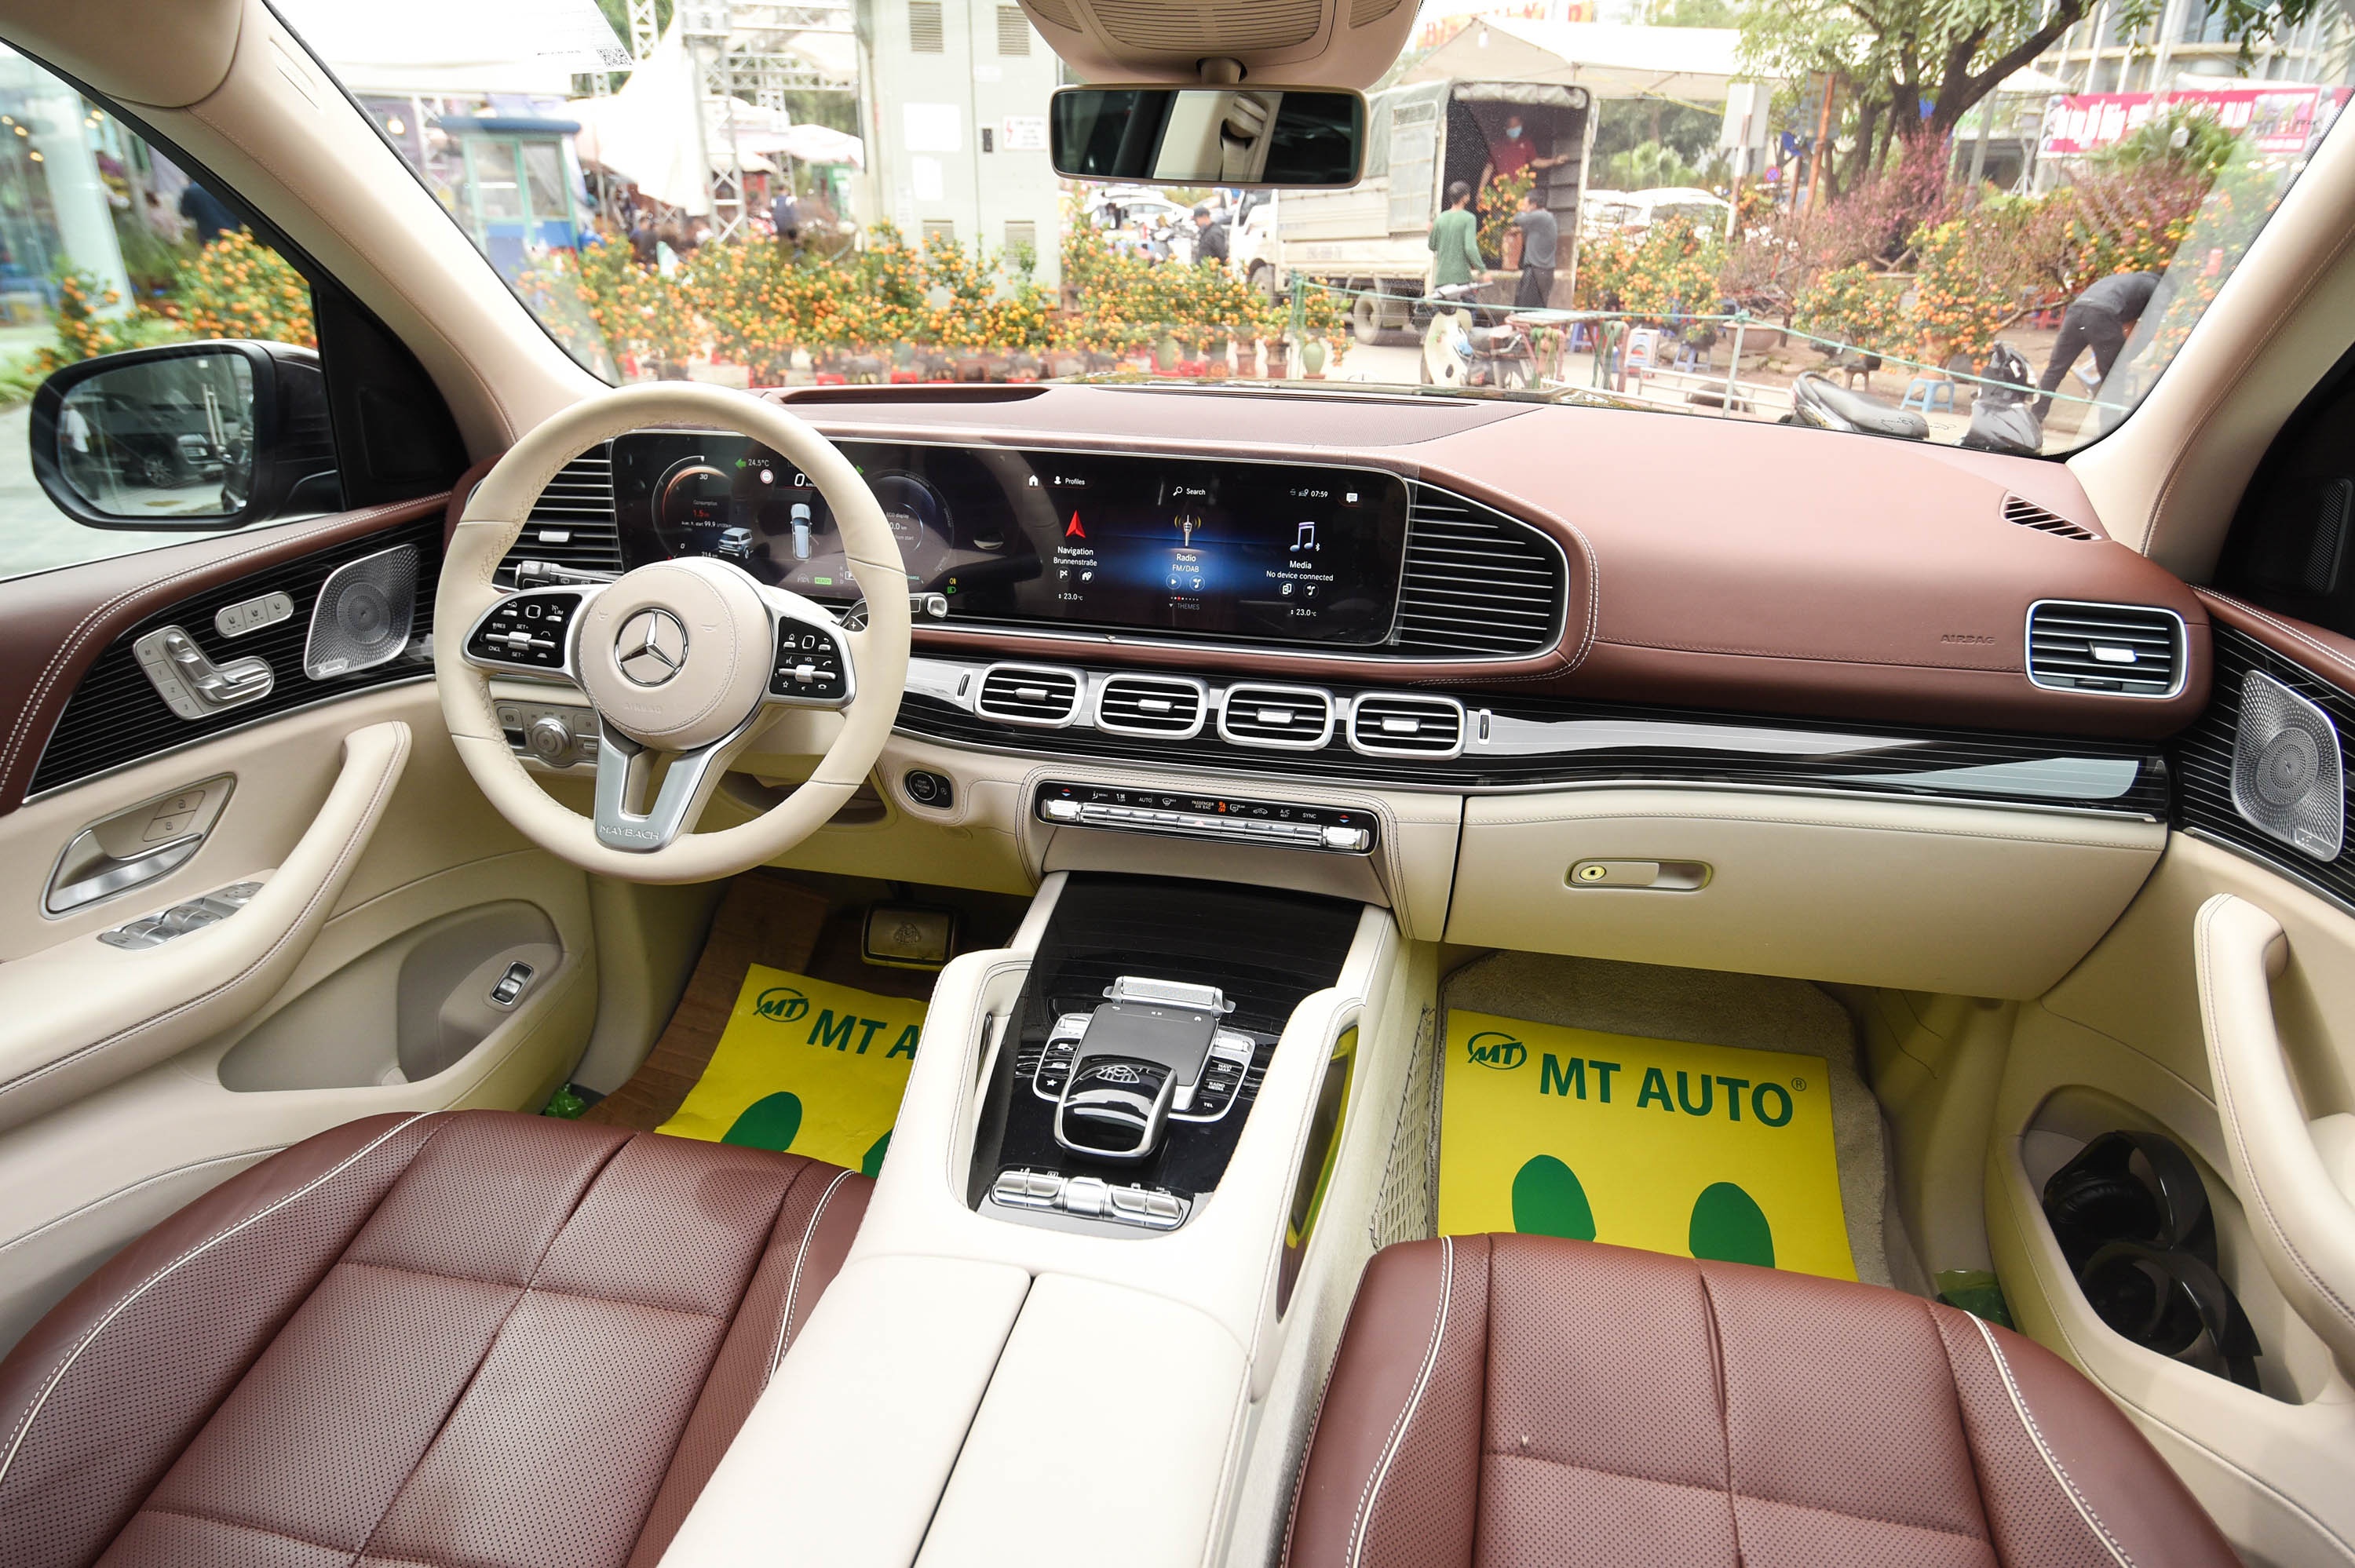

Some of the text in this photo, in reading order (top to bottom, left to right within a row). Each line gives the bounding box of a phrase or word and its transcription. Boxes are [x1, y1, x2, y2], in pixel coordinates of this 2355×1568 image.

[794, 473, 805, 487] 0
[1057, 545, 1094, 556] Navigation
[1053, 556, 1097, 567] Brunnenstraße
[1176, 553, 1196, 562] Radio
[1172, 563, 1199, 573] FM/DAB
[1289, 560, 1312, 569] Media
[1277, 571, 1298, 579] device
[1178, 602, 1200, 611] THEMES
[1940, 634, 1997, 646] AIRBAG
[599, 824, 659, 841] MAYBACH
[806, 1008, 888, 1055] MT
[1539, 1052, 1621, 1104] MT
